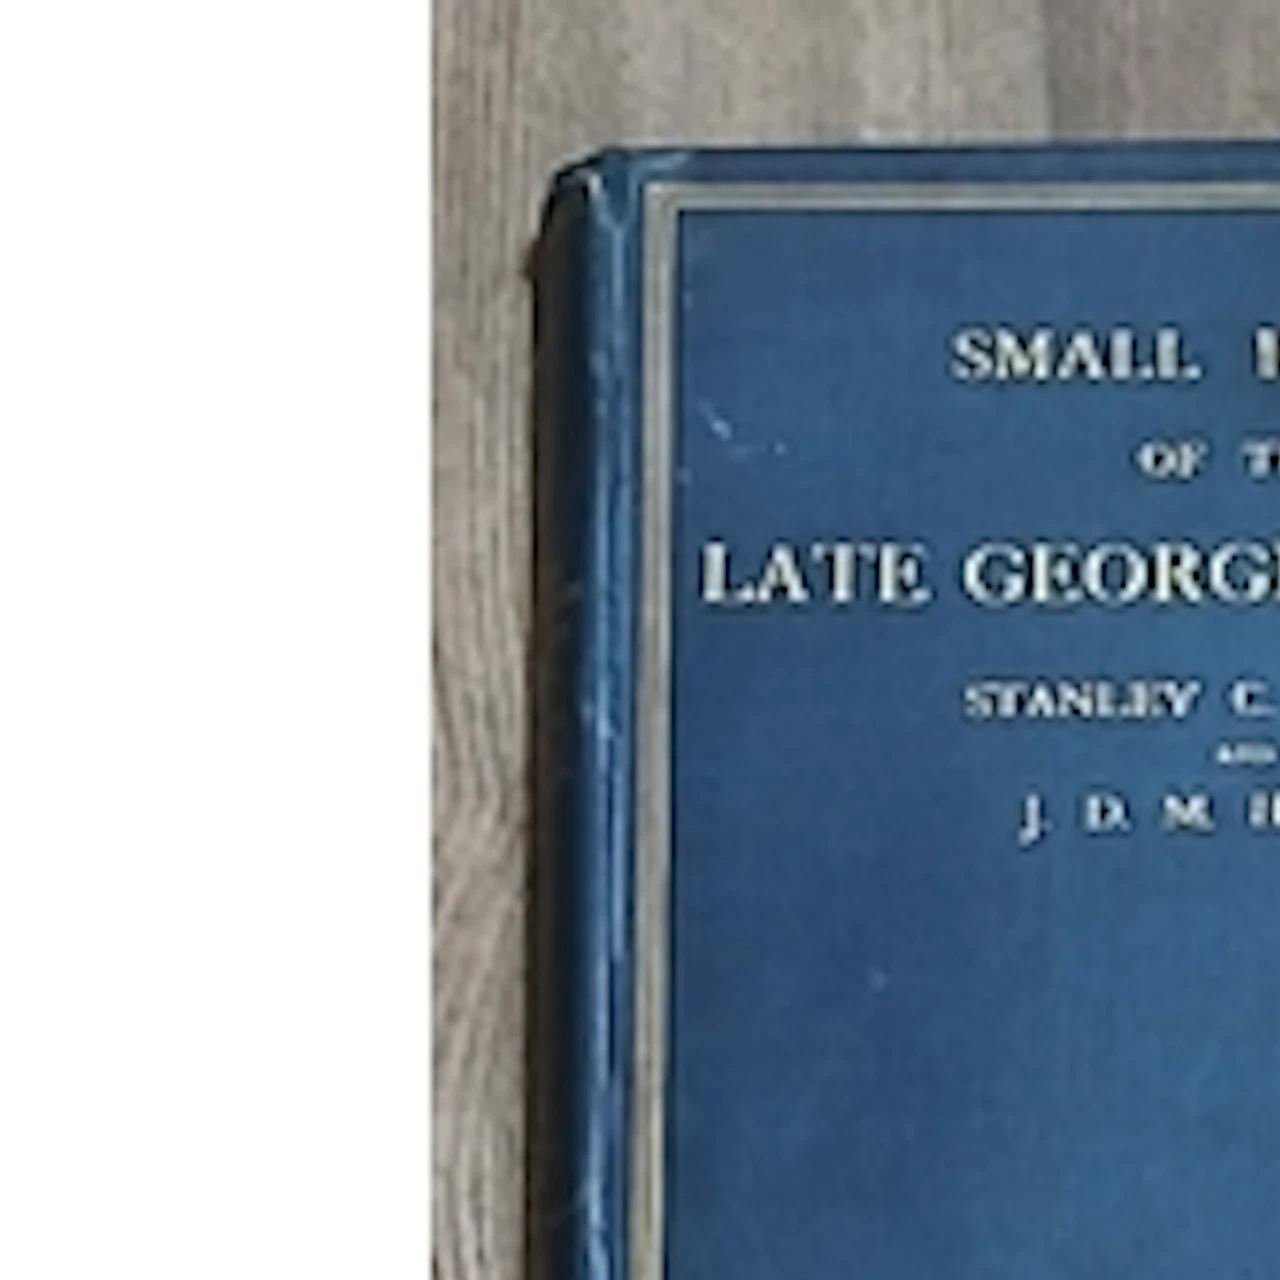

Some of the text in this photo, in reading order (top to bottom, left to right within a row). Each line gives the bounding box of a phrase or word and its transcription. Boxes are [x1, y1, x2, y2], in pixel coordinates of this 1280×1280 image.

[950, 326, 1202, 381] SMALL
[1136, 438, 1208, 480] OF
[699, 539, 932, 605] LATE
[964, 680, 1202, 719] STANLEY
